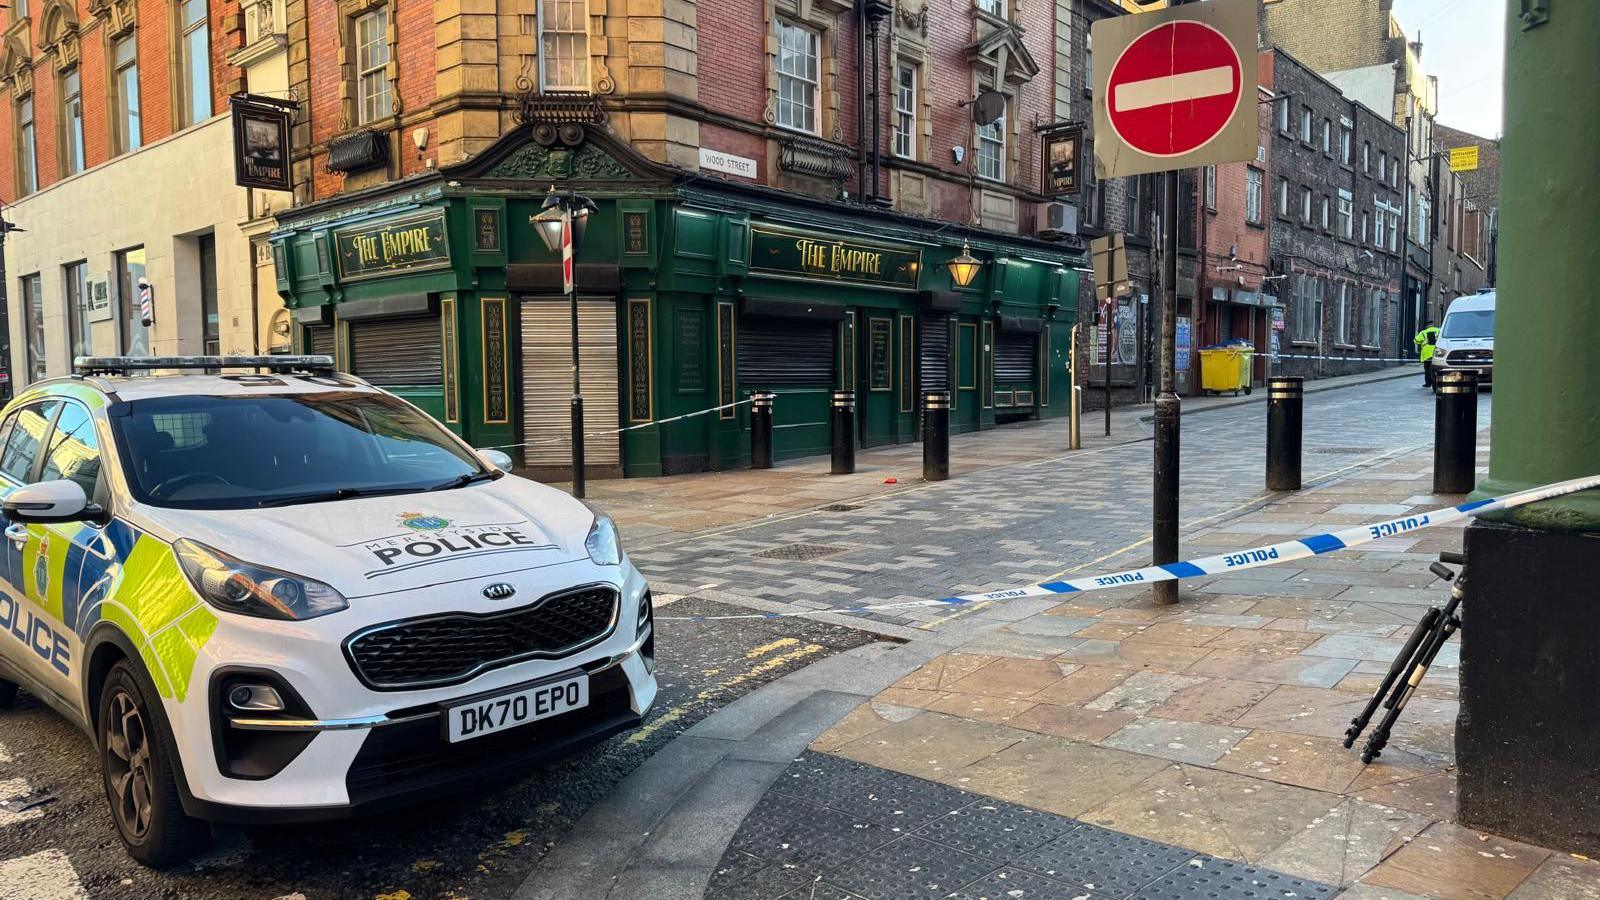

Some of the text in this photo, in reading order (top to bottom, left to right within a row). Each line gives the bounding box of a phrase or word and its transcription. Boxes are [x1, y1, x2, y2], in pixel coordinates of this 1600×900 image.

[248, 163, 282, 179] EMPIRE
[705, 153, 750, 172] WOOD STREET
[353, 226, 432, 269] THE EMPIRE
[796, 240, 882, 274] THE EMPIRE
[364, 524, 518, 551] MERSEYSIDE
[373, 531, 534, 566] POLICE
[1223, 547, 1279, 567] POLICE
[1095, 571, 1145, 586] POLICE
[486, 583, 513, 598] KIA
[983, 590, 1027, 599] POLICE
[0, 589, 70, 678] OLICE
[460, 681, 579, 736] DK70 EPO
